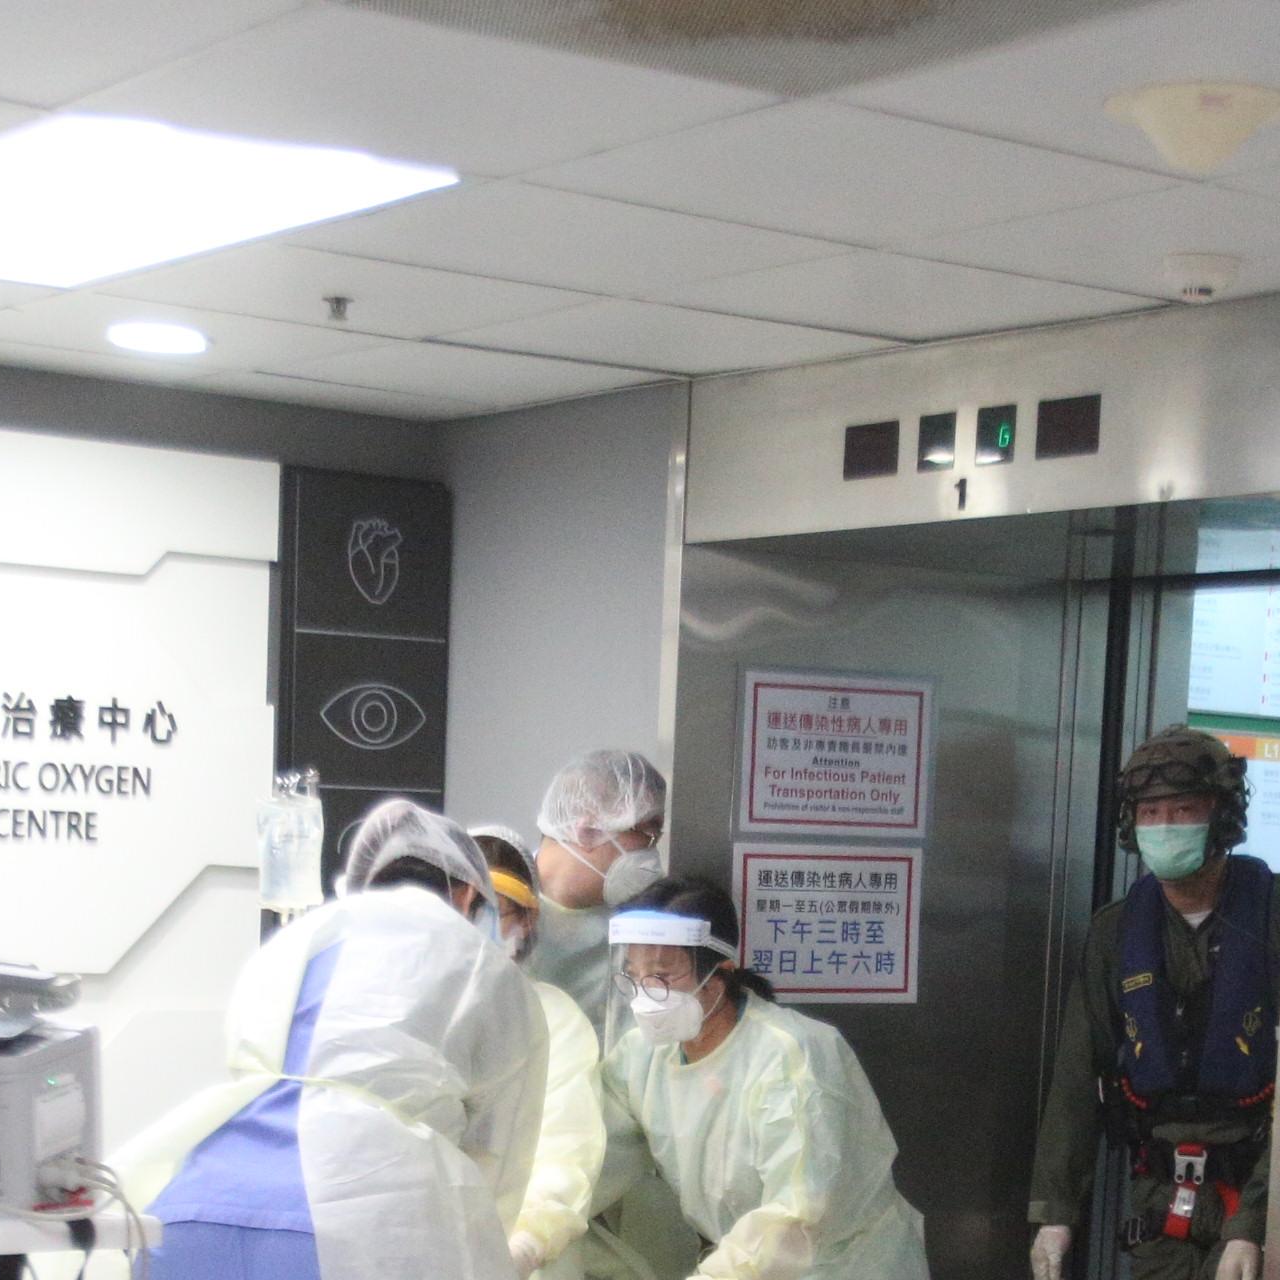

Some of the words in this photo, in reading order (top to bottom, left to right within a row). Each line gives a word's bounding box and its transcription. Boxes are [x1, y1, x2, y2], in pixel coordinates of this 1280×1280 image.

[998, 424, 1011, 448] G
[954, 477, 968, 512] 1
[767, 711, 908, 736] 運送傳染性病人專用
[812, 755, 861, 767] Attention
[38, 761, 153, 797] OXYGEN
[764, 765, 787, 781] For
[790, 769, 856, 783] Infectious
[860, 770, 907, 785] Patient
[769, 784, 866, 802] Transportation
[870, 789, 901, 804] Only
[758, 869, 898, 890] 運送傳染性病人專用
[767, 919, 885, 945] 下午三時至
[752, 950, 896, 975] 翌日上午六時
